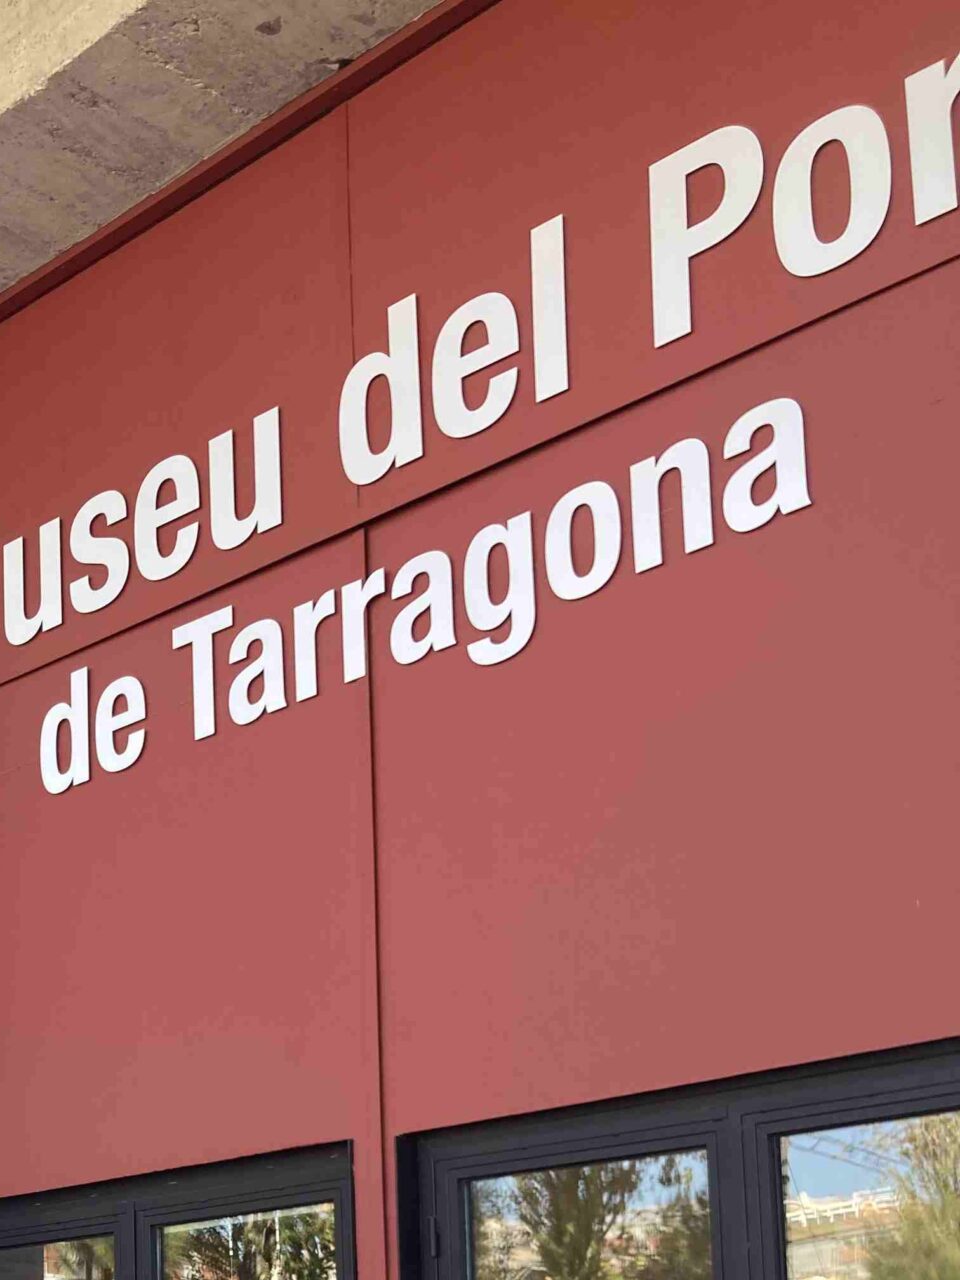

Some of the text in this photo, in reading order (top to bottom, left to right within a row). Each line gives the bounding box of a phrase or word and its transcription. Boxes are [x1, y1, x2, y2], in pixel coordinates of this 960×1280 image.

[338, 214, 569, 486] del
[39, 397, 812, 795] de Tarragona
